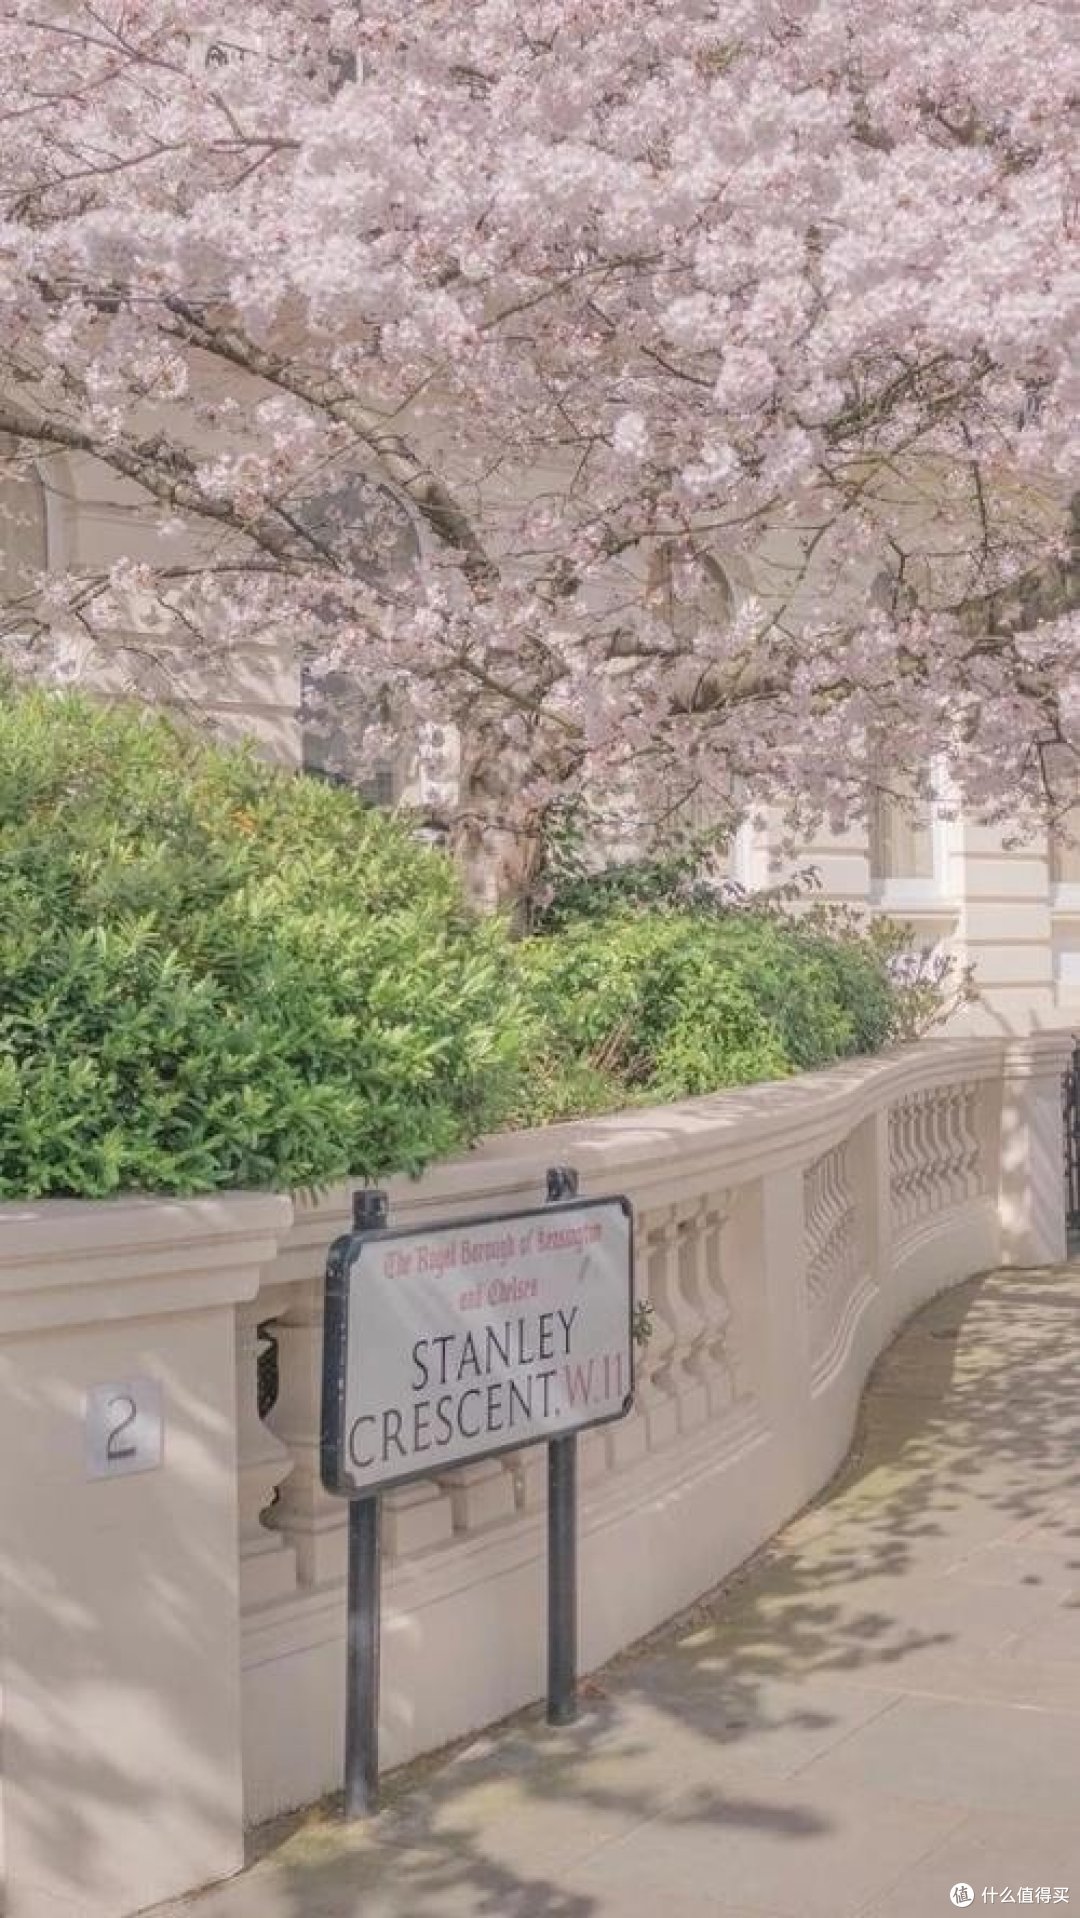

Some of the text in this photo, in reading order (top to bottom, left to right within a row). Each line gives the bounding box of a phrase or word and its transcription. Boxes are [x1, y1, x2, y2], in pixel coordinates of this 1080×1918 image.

[520, 1231, 534, 1255] of
[411, 1306, 578, 1391] STANLEY
[107, 1395, 136, 1459] 2
